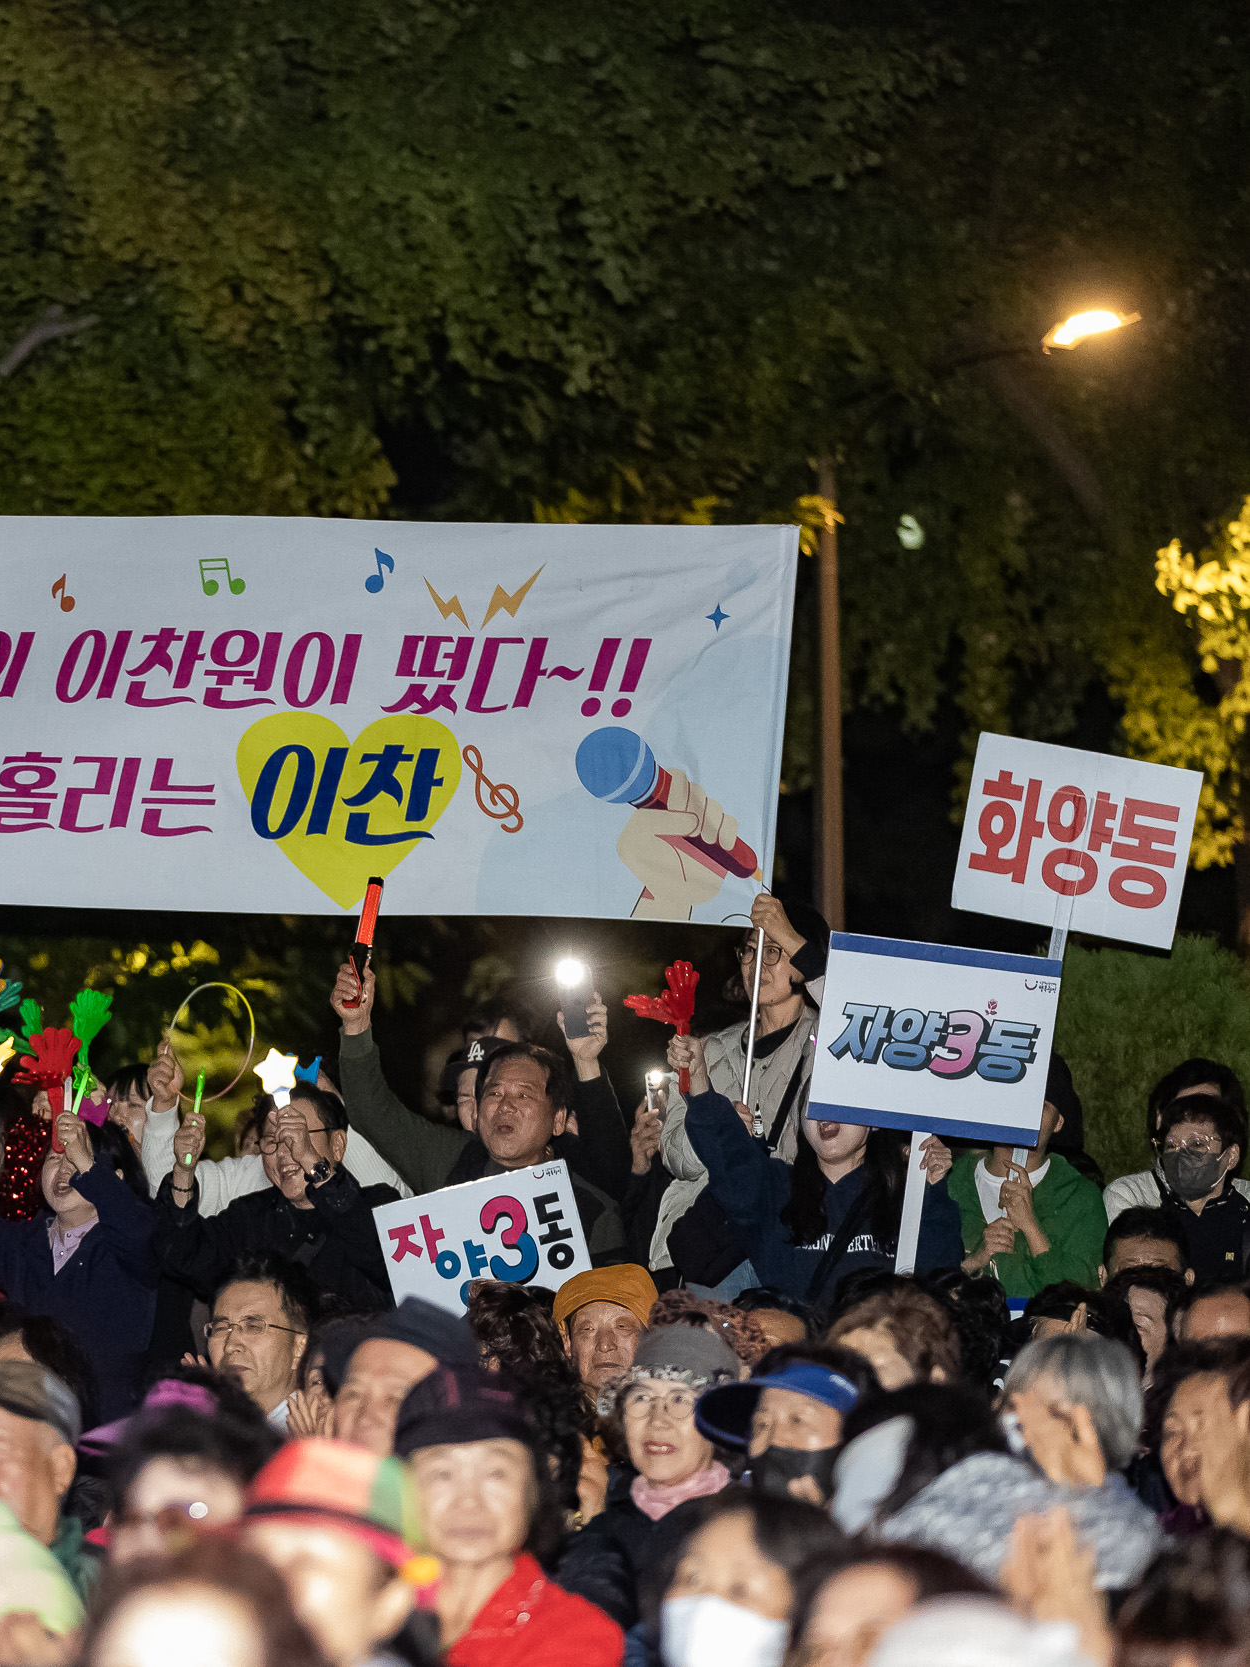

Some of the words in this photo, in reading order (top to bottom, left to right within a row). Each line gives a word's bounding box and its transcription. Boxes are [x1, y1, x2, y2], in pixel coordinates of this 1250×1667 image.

[56, 627, 363, 710] 이찬원이
[380, 634, 653, 718] 떴다~!!
[250, 743, 445, 847] 이찬
[967, 769, 1181, 910] 화양동
[467, 1040, 485, 1063] LA
[827, 1002, 1043, 1084] 자양3동
[388, 1191, 574, 1306] 자양3동
